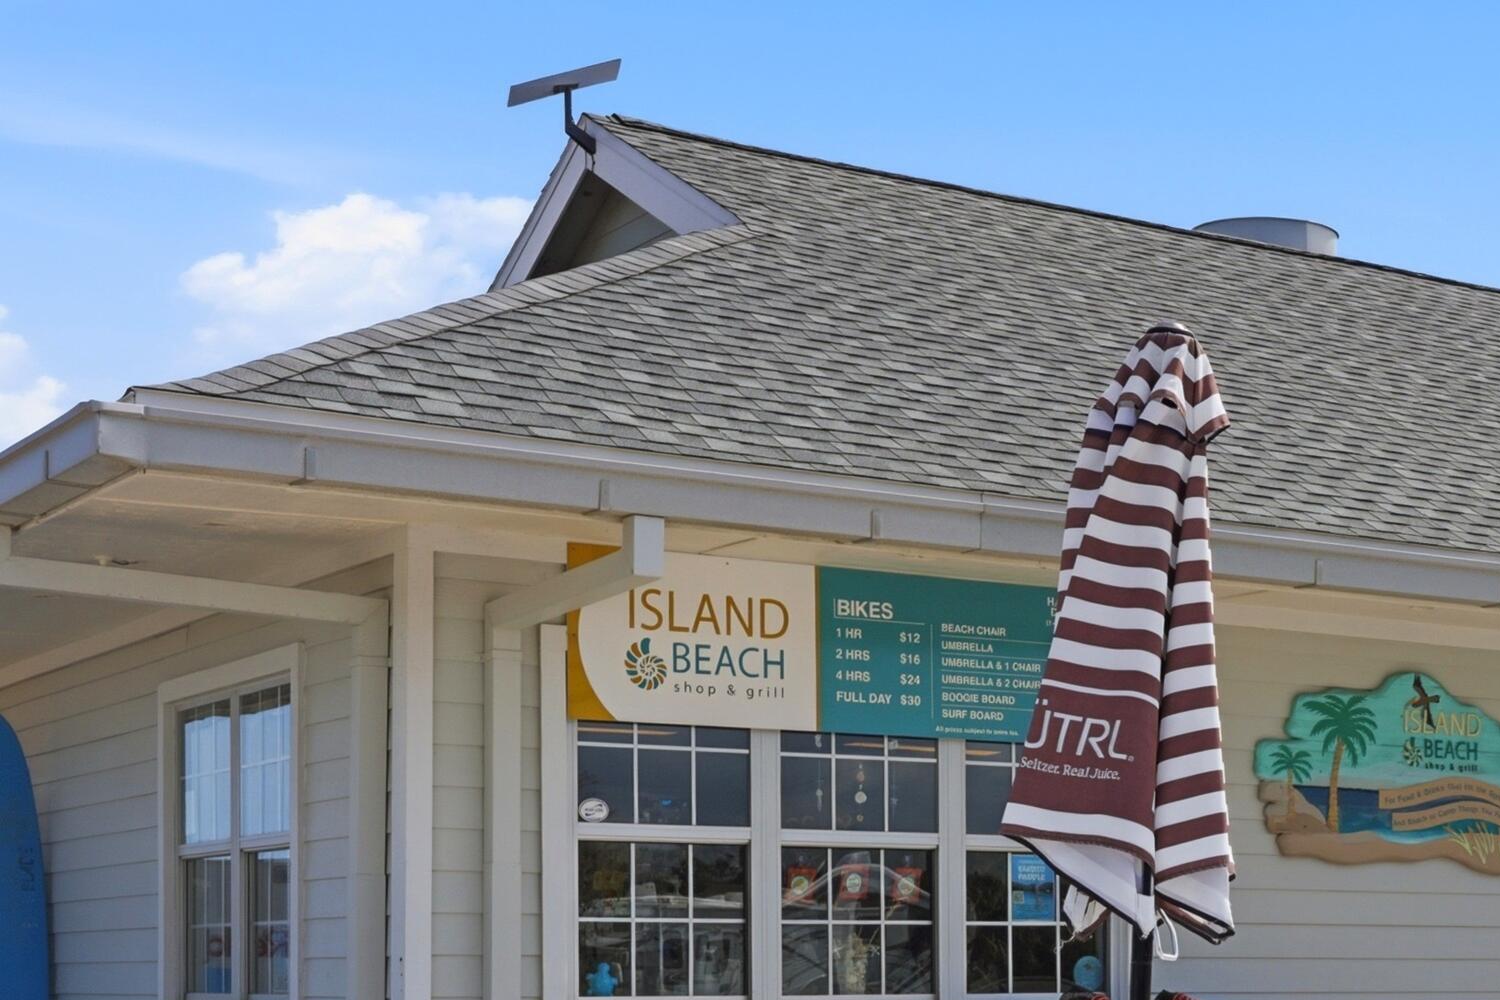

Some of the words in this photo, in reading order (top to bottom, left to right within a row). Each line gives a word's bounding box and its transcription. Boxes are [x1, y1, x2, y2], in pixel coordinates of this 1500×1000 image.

[628, 588, 789, 639] ISLAND
[837, 598, 894, 620] BIKES
[836, 627, 841, 638] 1
[845, 628, 862, 639] HR
[899, 632, 921, 644] $12
[941, 623, 975, 634] BEACH
[976, 626, 1007, 636] CHAIR
[941, 641, 994, 653] UMBRELLA
[672, 642, 785, 680] BEACH
[835, 648, 843, 660] 2
[845, 649, 871, 661] HRS
[900, 653, 921, 665] $16
[941, 657, 994, 670] UMBRELLA
[1005, 662, 1009, 671] 1
[1012, 662, 1041, 673] CHAIR
[835, 670, 842, 680] 4
[845, 670, 871, 682] HRS
[900, 674, 920, 685] $24
[941, 674, 994, 686] UMBRELLA
[1004, 679, 1010, 688] 2
[674, 681, 716, 696] shop
[727, 683, 736, 696] &
[746, 686, 785, 700] grill
[836, 691, 866, 703] FULL
[869, 693, 893, 704] DAY
[900, 695, 921, 706] $30
[941, 692, 980, 704] BOOGIE
[981, 694, 1016, 705] BOARD
[941, 708, 968, 719] SURF
[969, 710, 1004, 721] BOARD
[1404, 708, 1482, 737] ISLAND
[1423, 738, 1478, 761] BEACH
[1021, 756, 1060, 775] Seltzer.
[1063, 764, 1089, 778] Real
[1090, 768, 1121, 780] Juice.
